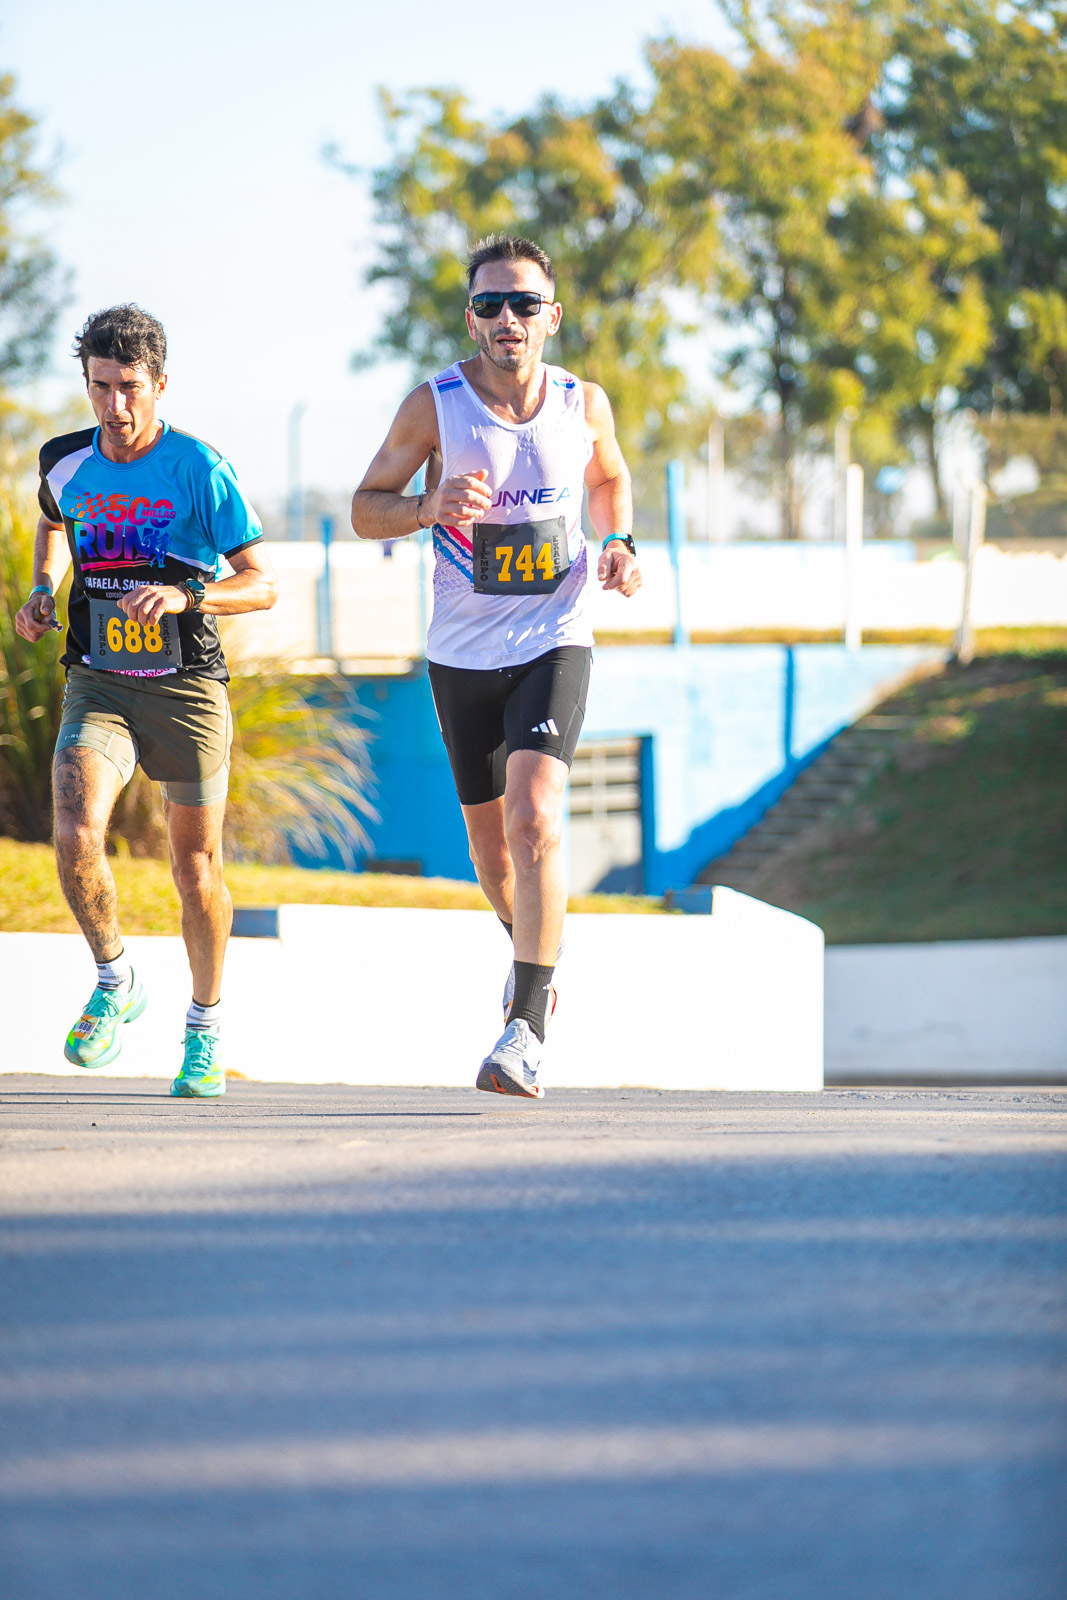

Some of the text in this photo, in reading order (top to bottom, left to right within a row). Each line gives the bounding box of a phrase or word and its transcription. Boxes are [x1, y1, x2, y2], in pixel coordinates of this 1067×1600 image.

[141, 509, 176, 519] MILLAS
[491, 487, 570, 508] UNNEA
[74, 521, 161, 560] RUN
[480, 539, 488, 581] TIEMPO
[553, 535, 561, 580] EXACTO
[495, 542, 554, 582] 744
[98, 613, 106, 656] TIEMPO
[106, 617, 163, 654] 688
[162, 615, 172, 656] EXACTO
